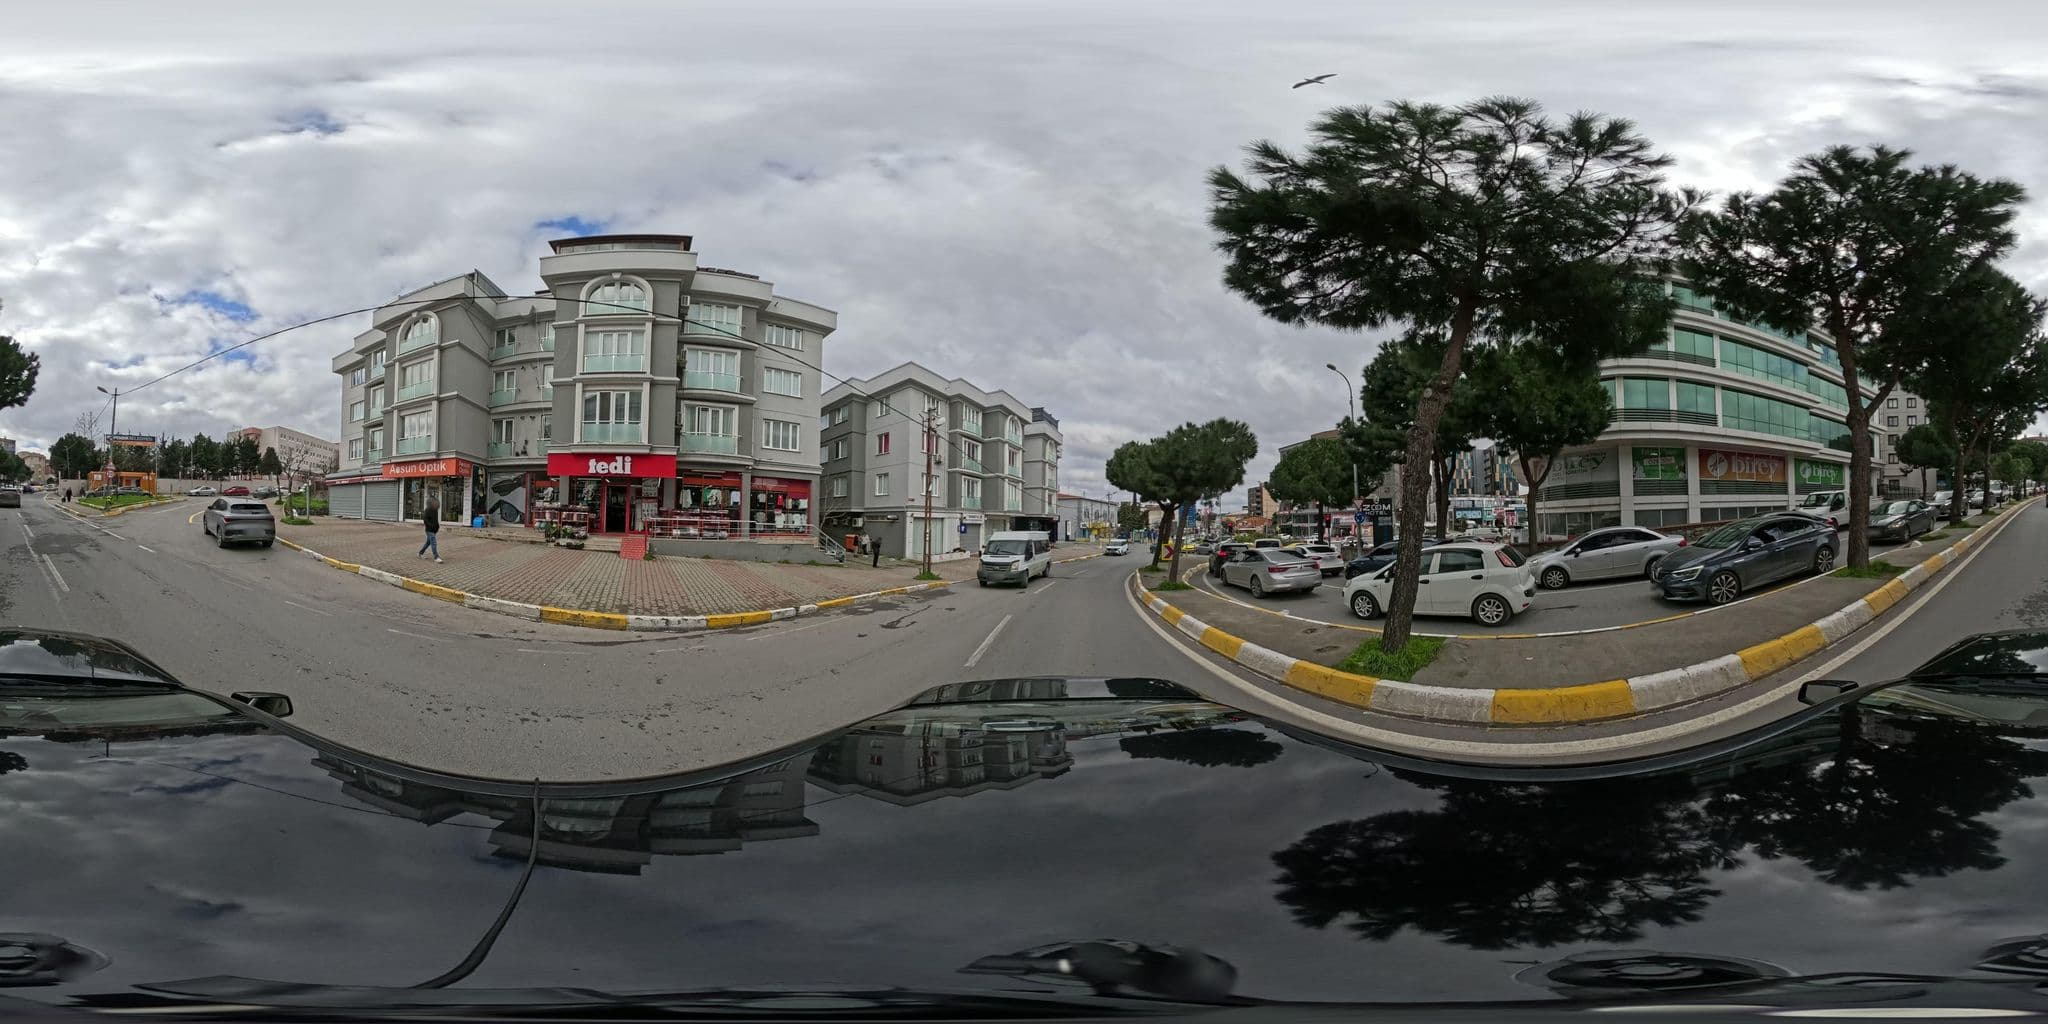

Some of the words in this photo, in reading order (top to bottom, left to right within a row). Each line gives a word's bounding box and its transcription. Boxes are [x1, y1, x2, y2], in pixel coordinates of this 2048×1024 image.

[588, 456, 632, 474] tedi
[1731, 455, 1778, 480] birey
[1362, 503, 1391, 511] ZOOM
